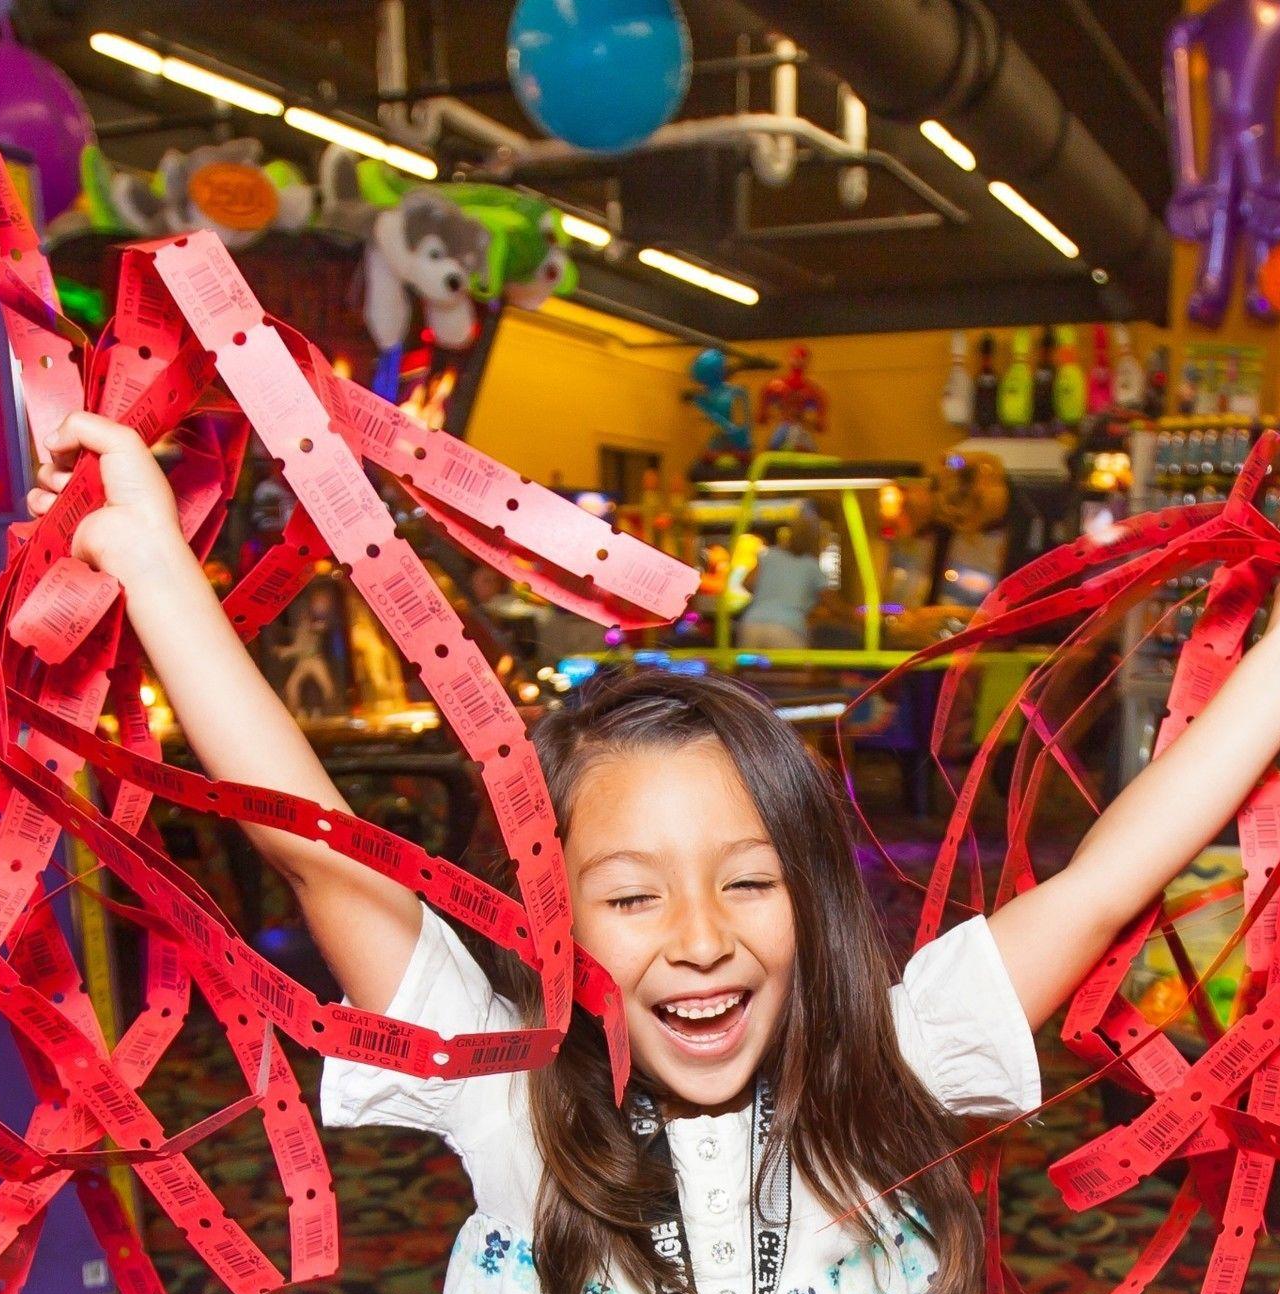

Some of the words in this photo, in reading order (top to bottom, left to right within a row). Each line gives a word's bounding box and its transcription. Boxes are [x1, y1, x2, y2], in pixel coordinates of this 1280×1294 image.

[399, 555, 428, 591] GREAT
[369, 584, 413, 640] LODGE
[466, 656, 494, 689] GREAT
[436, 682, 476, 740] LODGE
[332, 1009, 370, 1027] GREAT
[333, 1046, 403, 1068] LODGE
